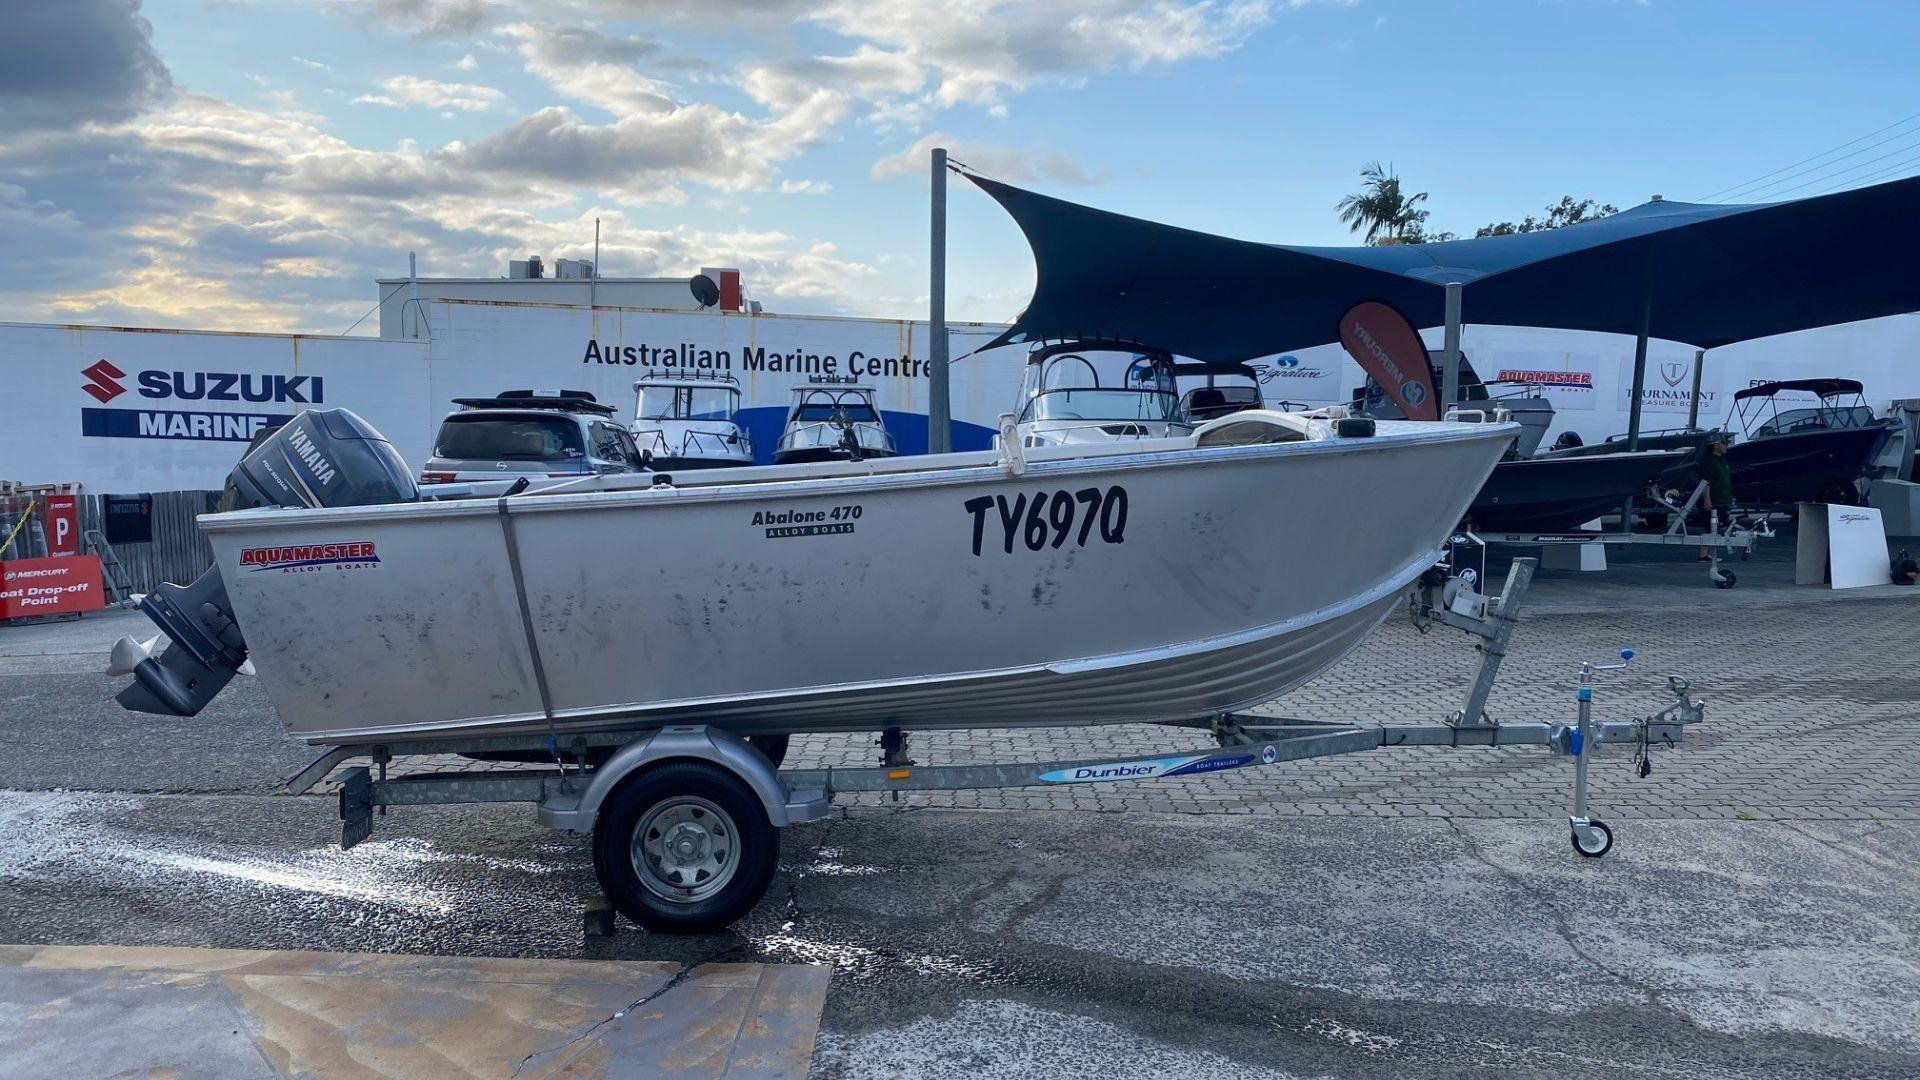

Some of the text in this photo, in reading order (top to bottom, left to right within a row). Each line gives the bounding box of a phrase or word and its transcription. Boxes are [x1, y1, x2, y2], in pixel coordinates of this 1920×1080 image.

[583, 339, 732, 370] Australian
[742, 346, 837, 375] Marine
[1252, 364, 1330, 384] Signature
[1498, 370, 1592, 384] AQUAMASTER
[137, 370, 324, 404] SUZUKI
[1626, 388, 1716, 400] TURNAMNT
[288, 426, 336, 486] YAMAHA
[751, 505, 863, 526] Abalone 470
[964, 485, 1129, 557] TY697Q
[56, 517, 69, 546] P
[768, 525, 853, 537] ALLOY BOATS
[240, 541, 376, 566] AQUAMASTER
[17, 568, 69, 578] MERCURY
[282, 563, 378, 574] ALLOY BOATS
[0, 583, 89, 598] oat Drop-off
[21, 596, 59, 606] Point
[1075, 765, 1157, 779] Dunbier
